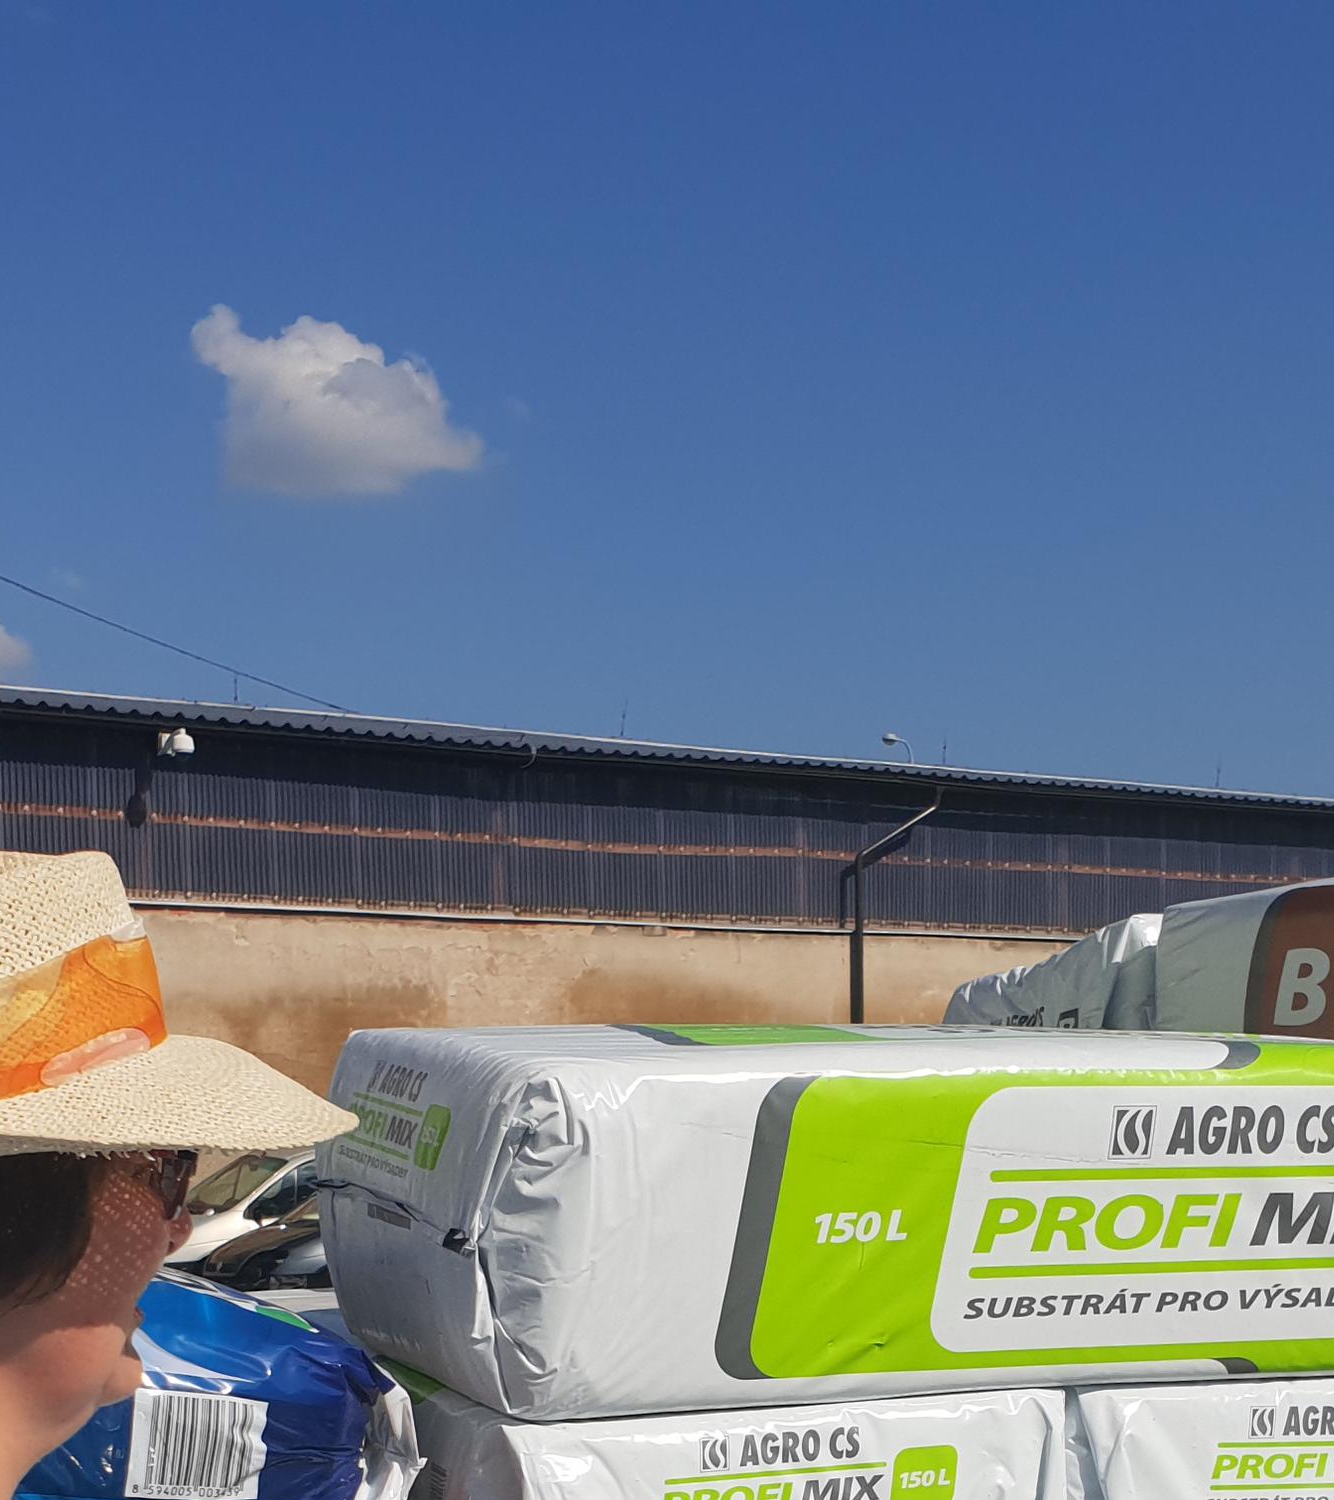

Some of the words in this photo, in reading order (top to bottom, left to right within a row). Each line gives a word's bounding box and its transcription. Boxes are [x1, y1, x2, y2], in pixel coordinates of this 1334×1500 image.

[1272, 948, 1331, 1026] B
[379, 1064, 414, 1098] AGRO
[409, 1072, 429, 1102] CS
[385, 1116, 417, 1149] MIX
[1166, 1105, 1285, 1155] AGRO
[972, 1193, 1242, 1254] PROFI
[963, 1288, 1151, 1321] SUBSTRÁT
[1155, 1290, 1229, 1313] PRO
[739, 1430, 820, 1467] AGRO
[832, 1426, 861, 1460] CS
[1211, 1453, 1328, 1480] PROFI
[132, 1484, 139, 1494] 8
[147, 1486, 192, 1497] 594005
